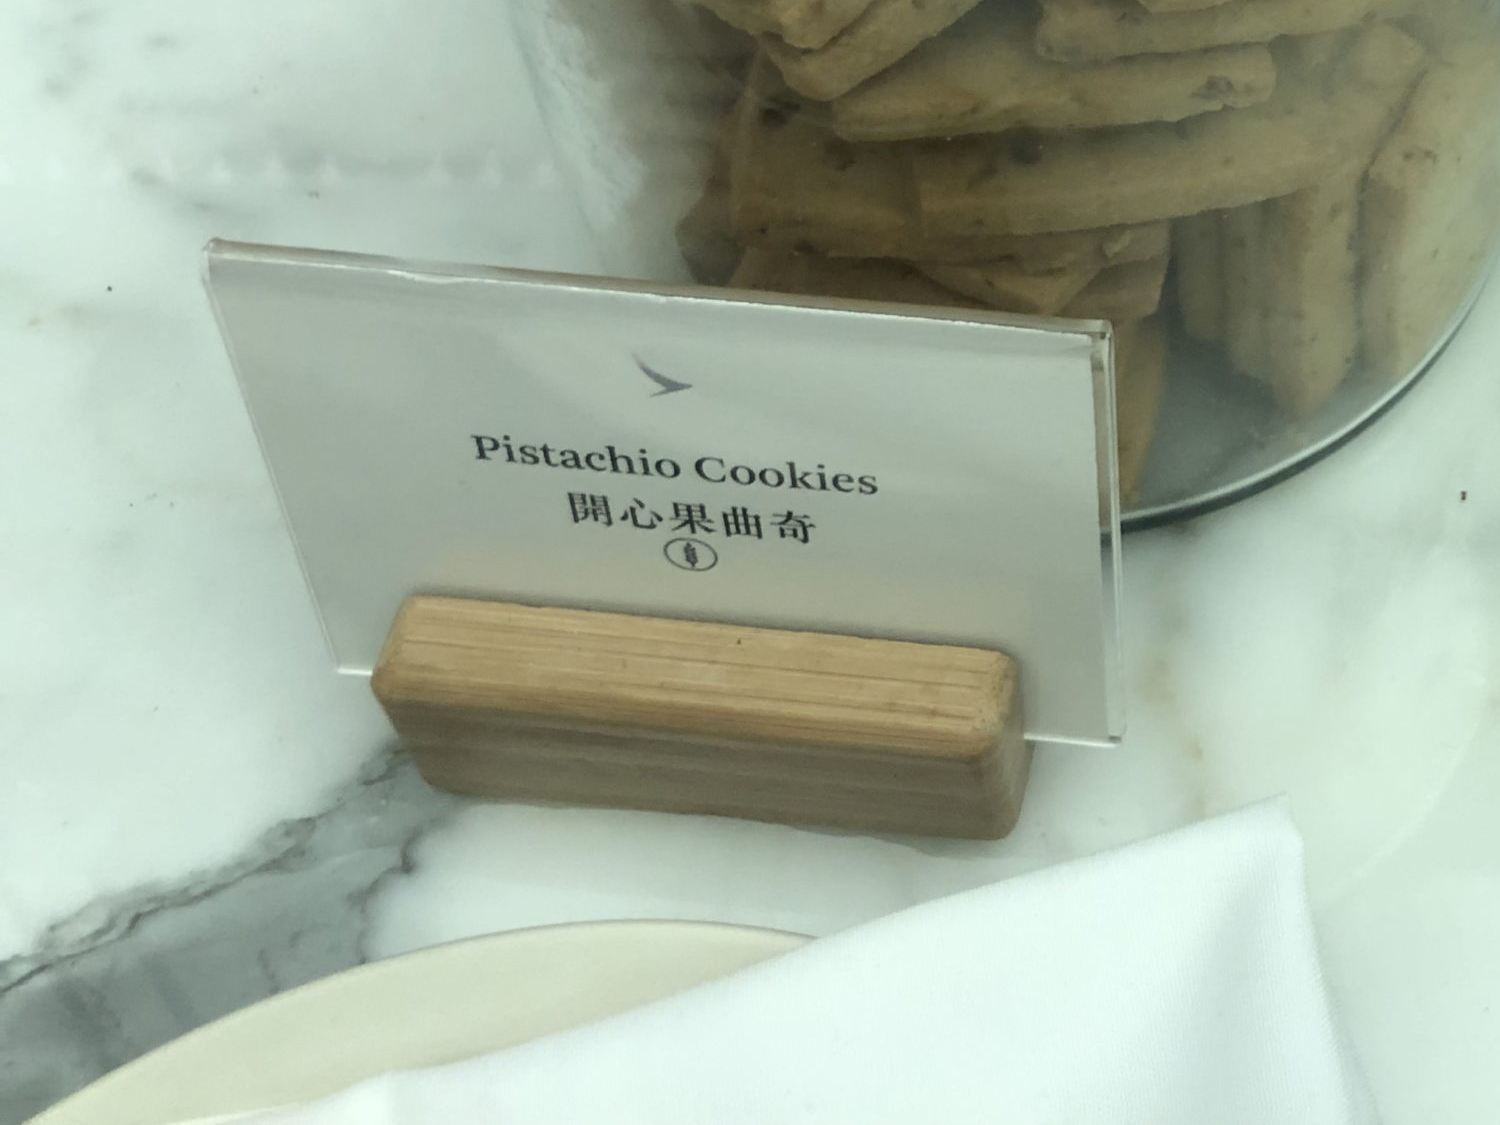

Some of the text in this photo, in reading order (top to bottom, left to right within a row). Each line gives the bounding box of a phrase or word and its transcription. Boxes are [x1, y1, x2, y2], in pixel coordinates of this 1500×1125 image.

[470, 433, 880, 496] Pistachio Cookies
[566, 490, 817, 545] 開心果曲奇
